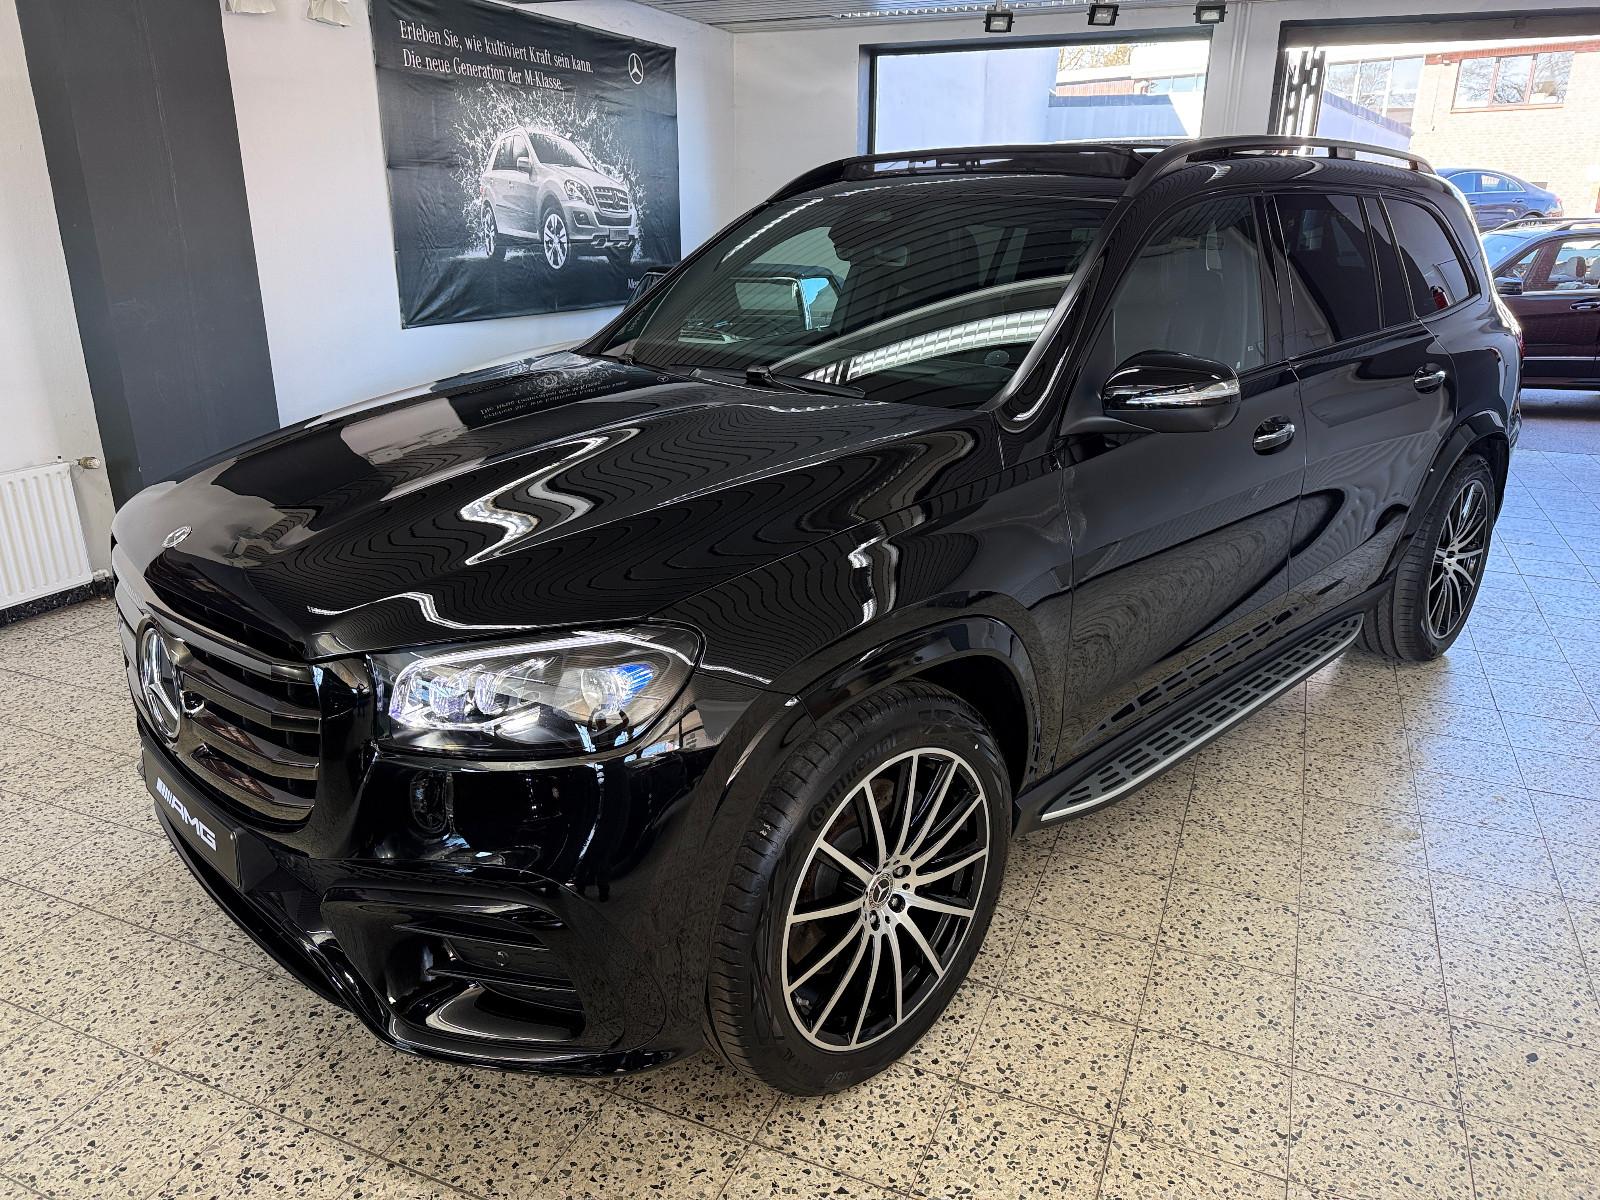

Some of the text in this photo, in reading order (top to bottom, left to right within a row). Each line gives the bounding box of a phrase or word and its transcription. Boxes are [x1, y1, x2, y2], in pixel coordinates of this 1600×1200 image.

[399, 19, 594, 74] Erleben Sie, wie kultiviert Kraft sein kann.
[402, 48, 564, 91] Die neue Generation der M-Klasse.
[169, 792, 217, 852] AMG
